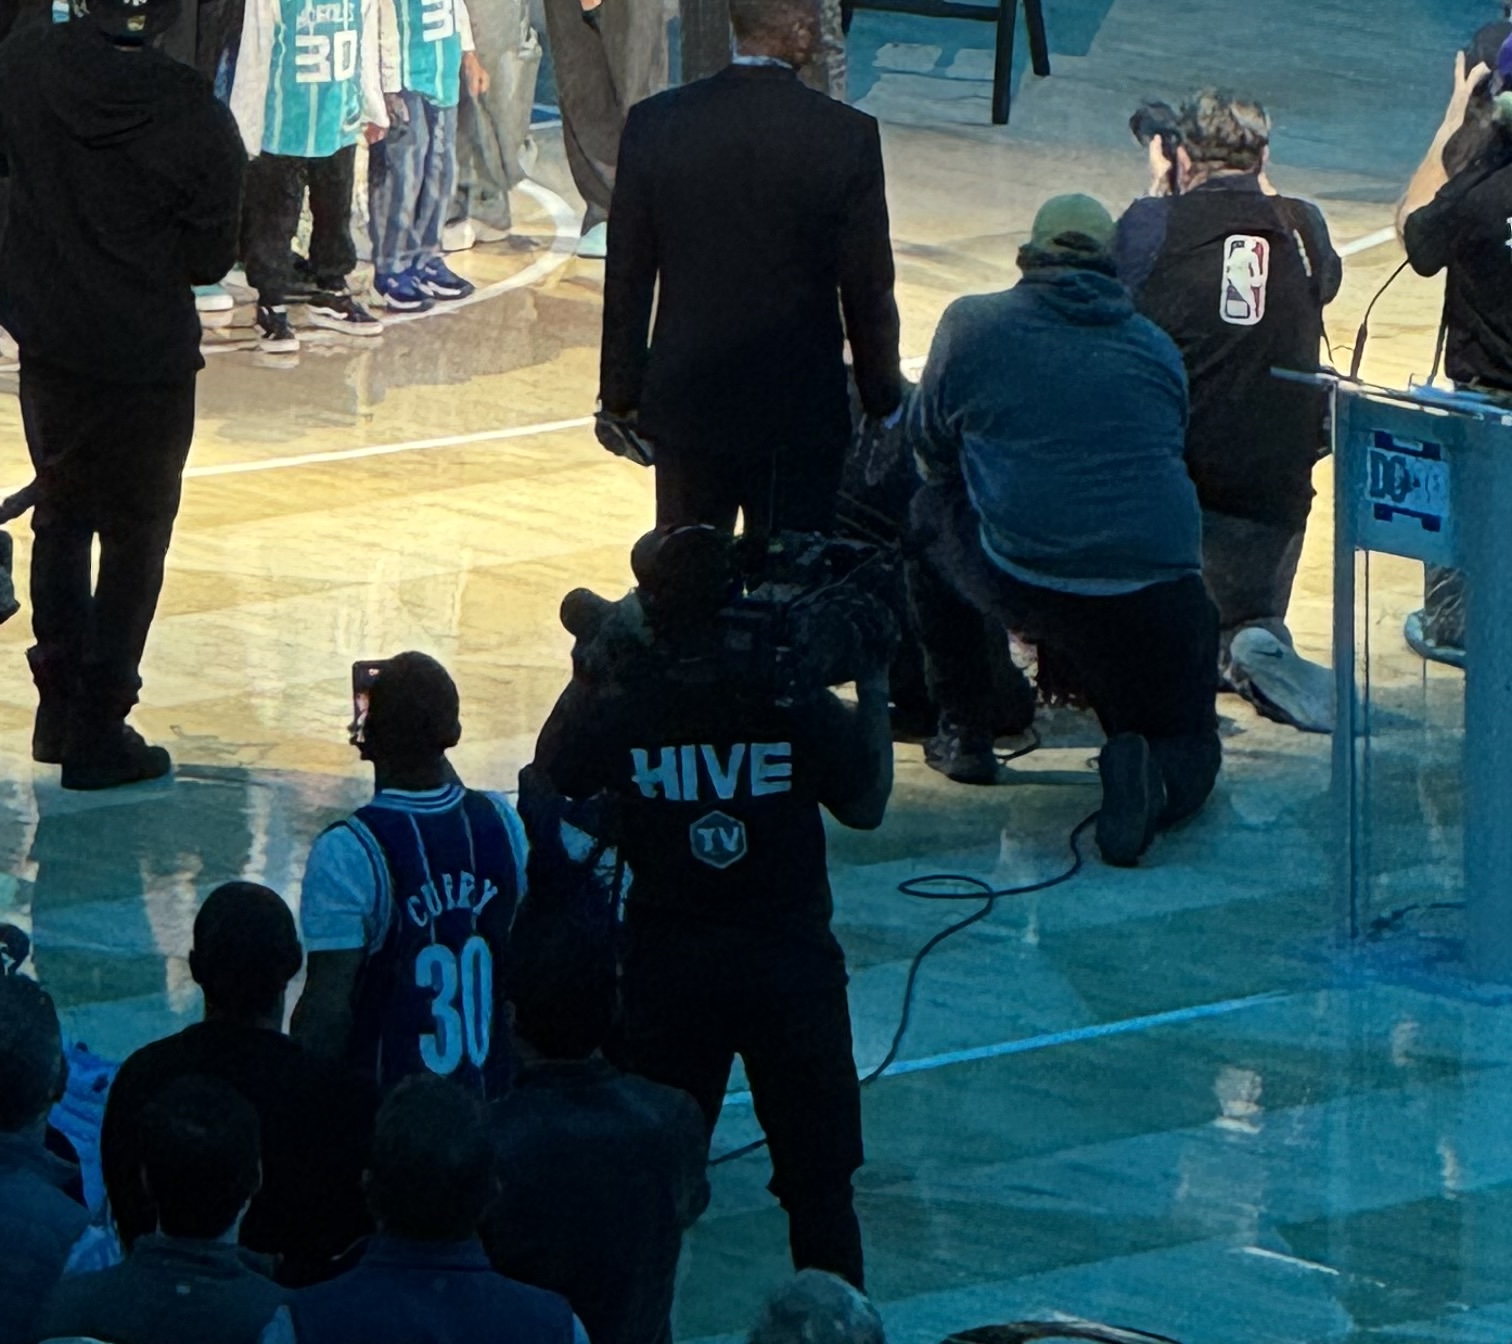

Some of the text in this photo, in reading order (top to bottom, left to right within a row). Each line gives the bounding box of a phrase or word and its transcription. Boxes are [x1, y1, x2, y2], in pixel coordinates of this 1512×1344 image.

[295, 29, 358, 83] 30
[631, 742, 792, 801] HIVE
[698, 826, 741, 853] TV
[407, 870, 498, 928] CURRY
[415, 935, 493, 1077] 30
